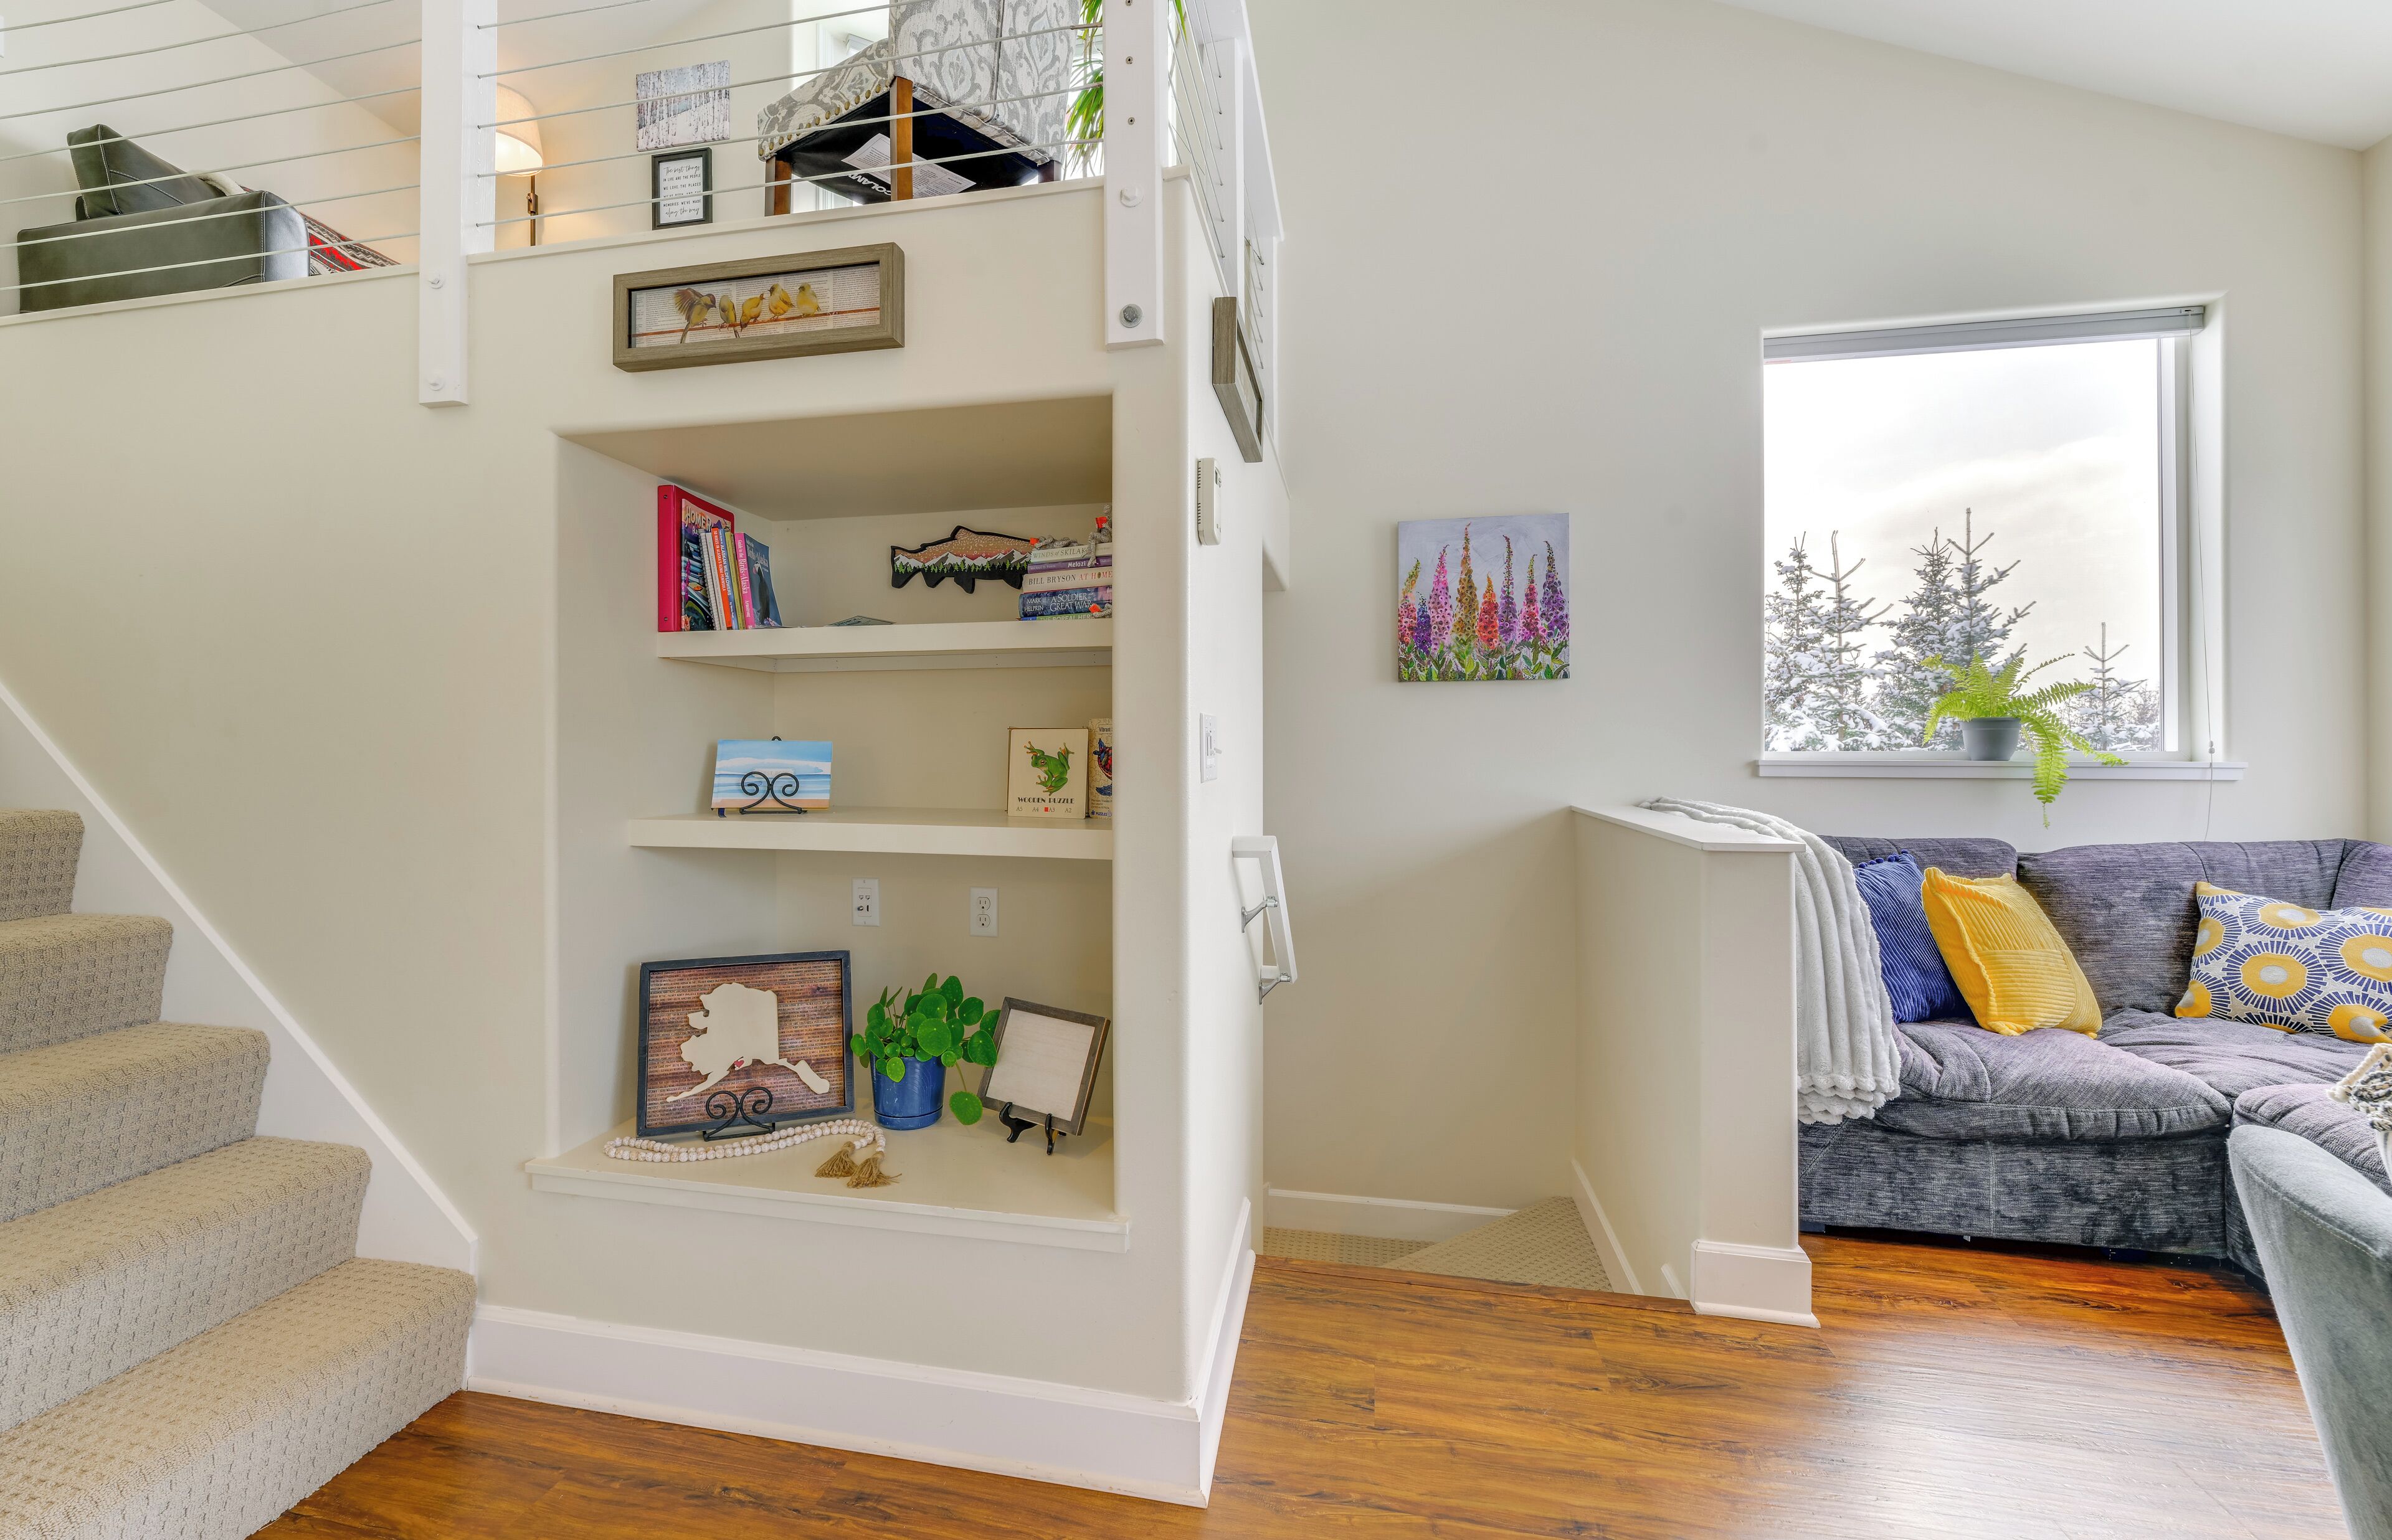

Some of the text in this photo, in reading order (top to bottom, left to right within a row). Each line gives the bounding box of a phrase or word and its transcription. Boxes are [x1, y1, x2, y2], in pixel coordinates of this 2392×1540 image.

[663, 167, 673, 176] The
[686, 165, 701, 174] things
[665, 206, 700, 217] along the way
[685, 506, 712, 531] HOMER
[1060, 547, 1086, 556] SKILAK
[739, 559, 748, 574] Birds
[1028, 577, 1045, 585] BILL
[1047, 574, 1076, 583] BRYSON
[1091, 571, 1113, 580] HOME
[740, 576, 750, 594] Alaska
[1058, 593, 1088, 602] SOLDIER
[1050, 601, 1073, 612] GREAT
[1073, 600, 1092, 610] WAR
